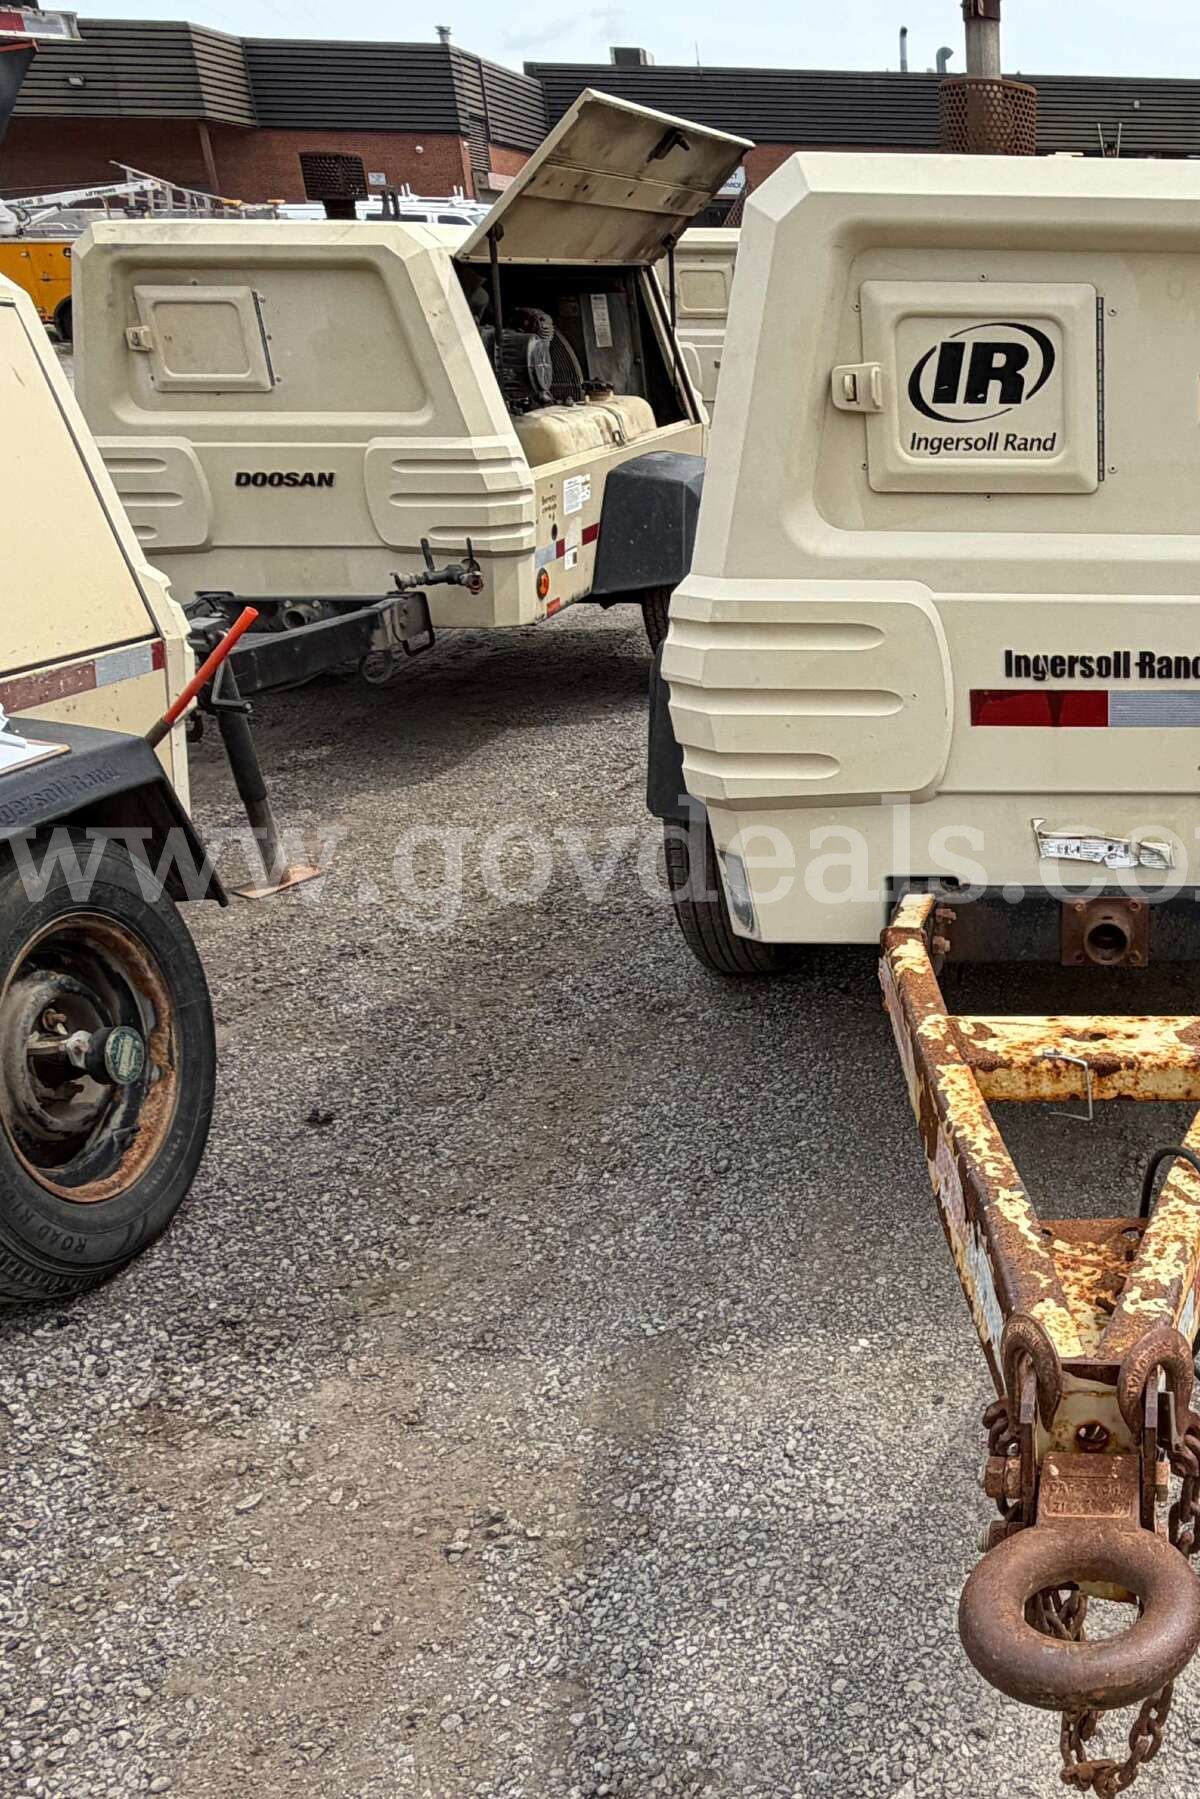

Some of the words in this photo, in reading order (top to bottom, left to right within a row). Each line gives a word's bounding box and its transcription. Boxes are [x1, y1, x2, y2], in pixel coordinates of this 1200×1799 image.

[931, 341, 1030, 405] IR
[910, 432, 999, 455] Ingersoll
[1003, 432, 1057, 451] Rand
[235, 471, 336, 487] DOOSAN
[1004, 649, 1131, 682] Ingersoll
